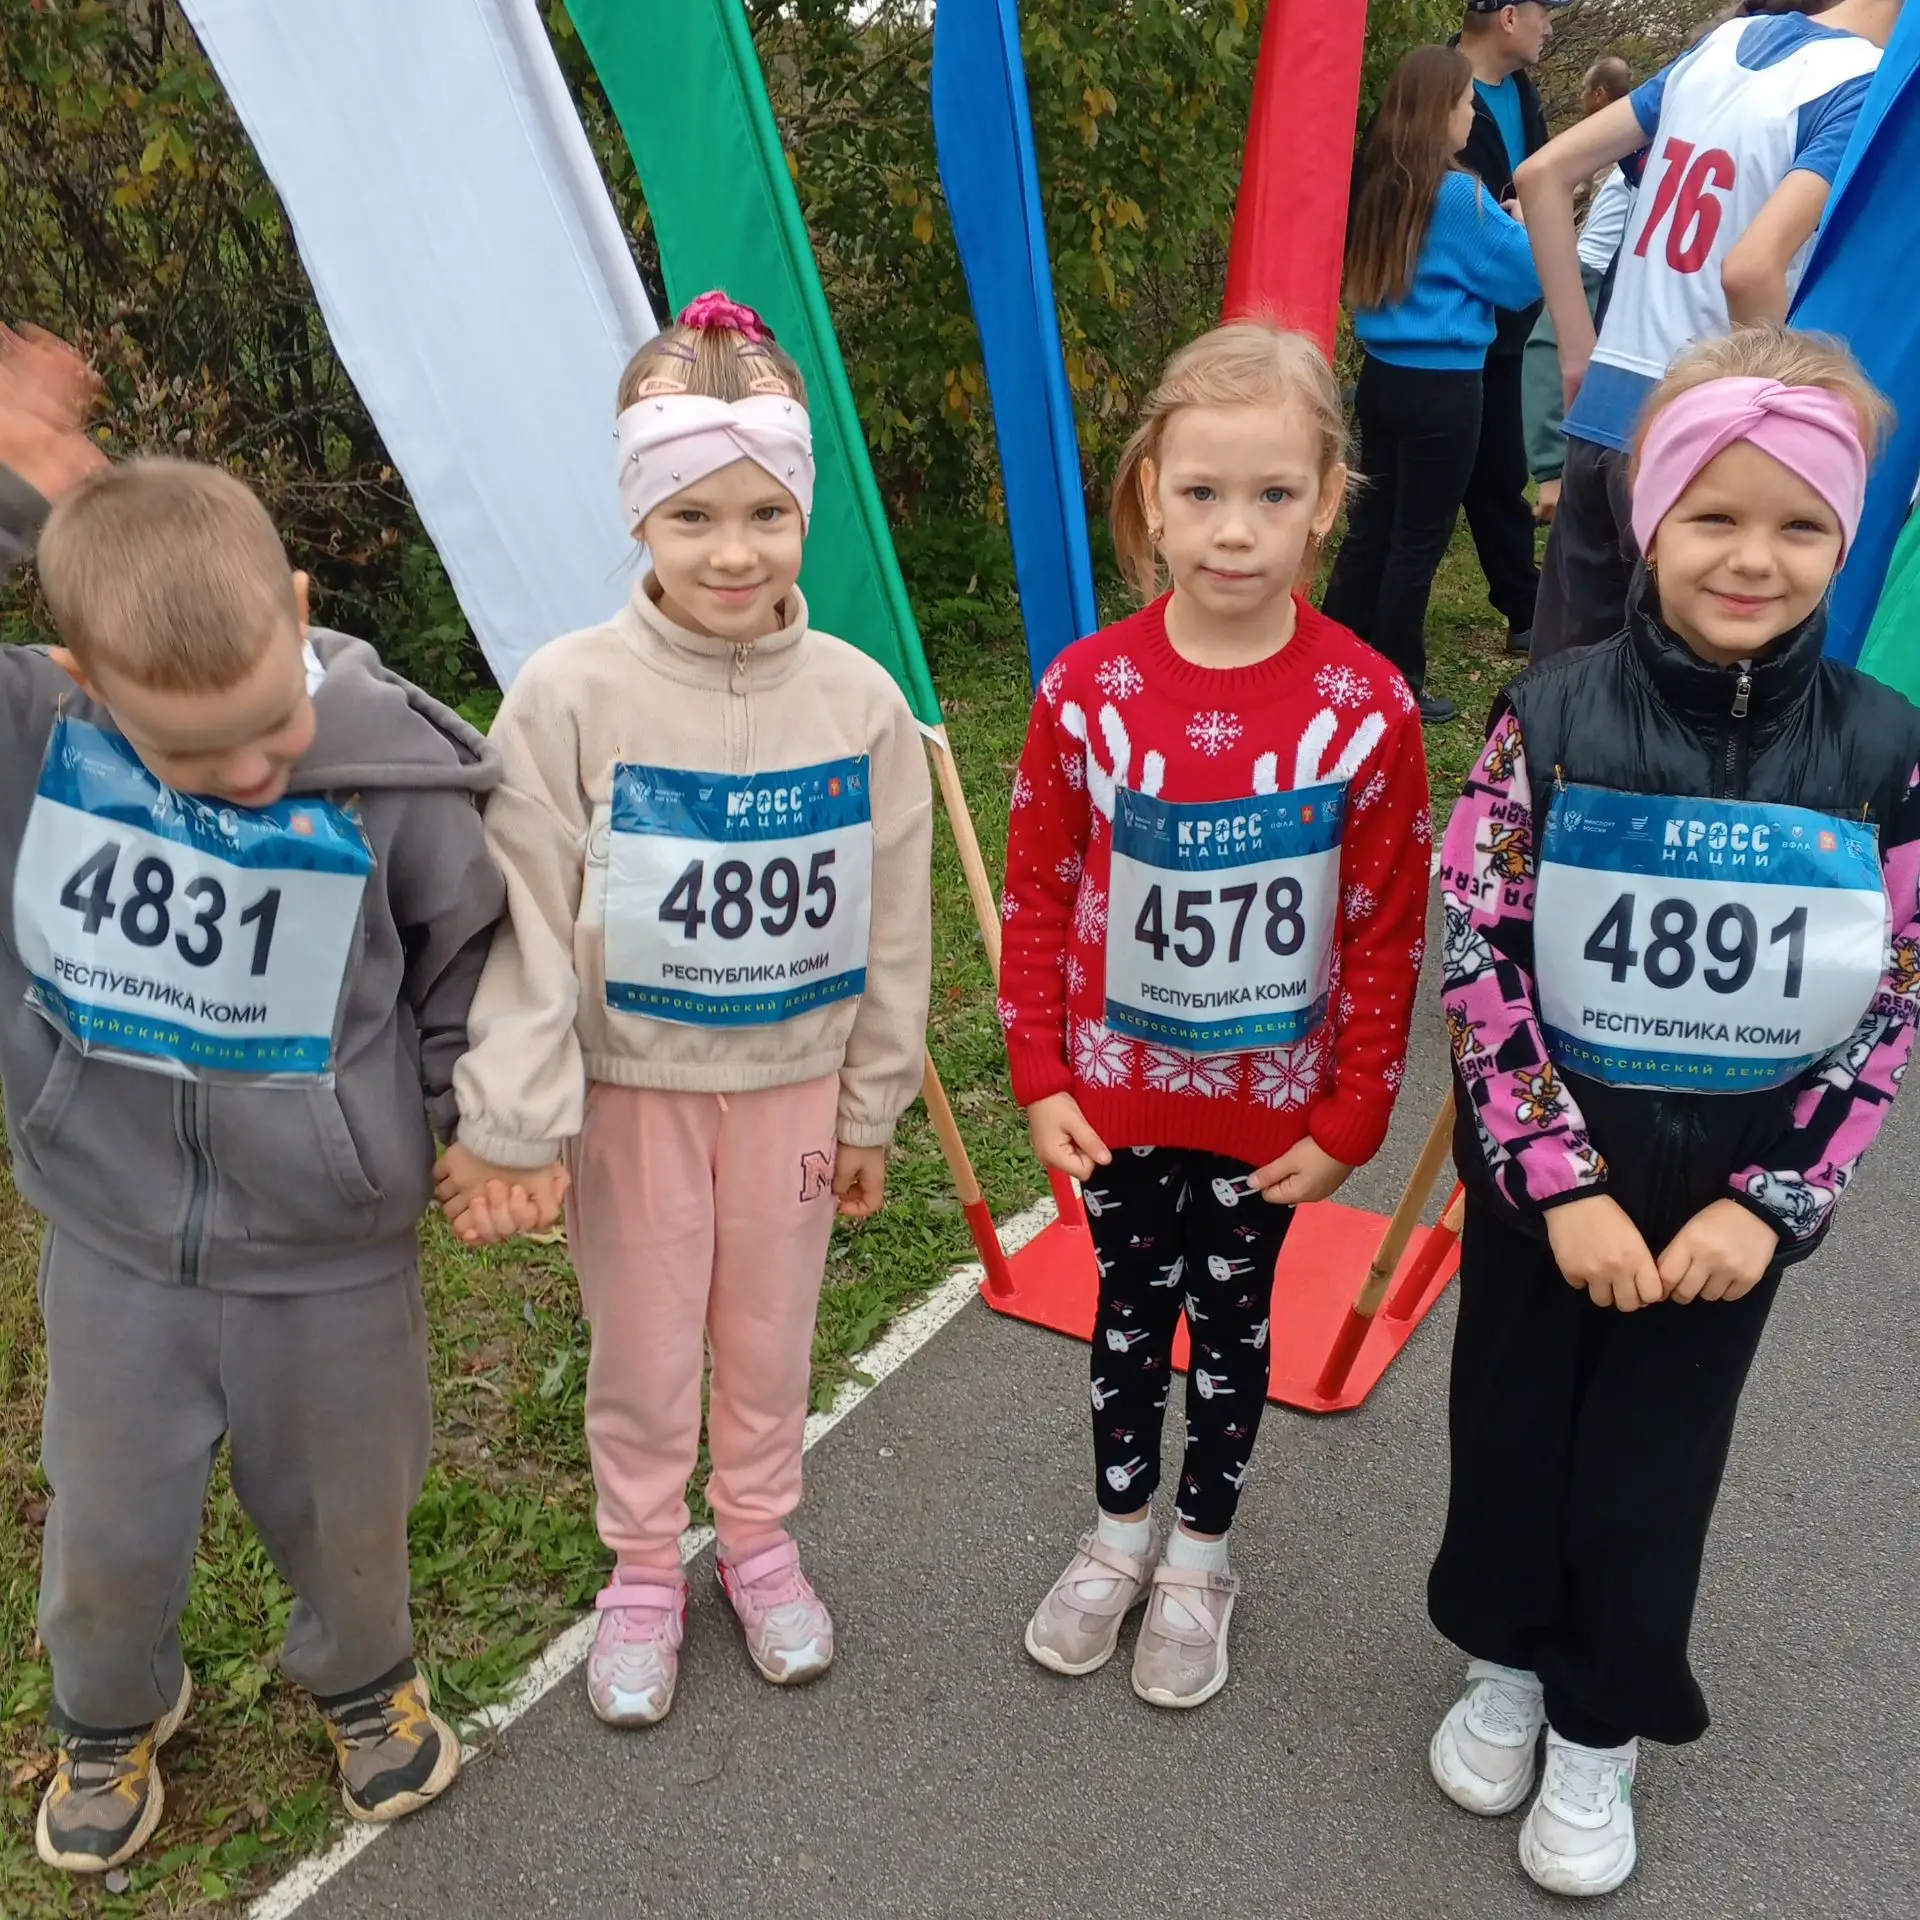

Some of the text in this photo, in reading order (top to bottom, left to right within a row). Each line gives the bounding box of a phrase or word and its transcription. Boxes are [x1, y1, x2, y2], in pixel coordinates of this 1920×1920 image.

[1633, 136, 1736, 274] 76
[727, 785, 803, 817] КРОСС
[726, 812, 803, 830] НАЦИИ
[1178, 812, 1263, 845] КРОСС
[1664, 819, 1772, 852] КРОСС
[1178, 838, 1263, 858] НАЦИИ
[1663, 848, 1769, 868] НАЦИИ
[59, 840, 282, 977] 4831
[658, 848, 837, 941] 4895
[1134, 876, 1306, 968] 4578
[1583, 891, 1809, 999] 4891
[661, 952, 830, 984] РЕСПУБЛИКА КОМИ
[53, 955, 267, 1024] РЕСПУБЛИКА КОМИ
[628, 990, 777, 1014] ВСЕРОССИЙСКИЙ
[785, 991, 816, 1009] ДЕНЬ
[1141, 979, 1307, 1009] РЕСПУБЛИКА КОМИ
[1119, 1011, 1297, 1040] ВСЕРОССИЙСКИЙ ДЕНЬ
[1582, 1006, 1802, 1046] РЕСПУБЛИКА КОМИ
[1558, 1039, 1714, 1076] ВСЕРОССИЙСКИЙ
[1725, 1064, 1777, 1077] ДЕНЬ
